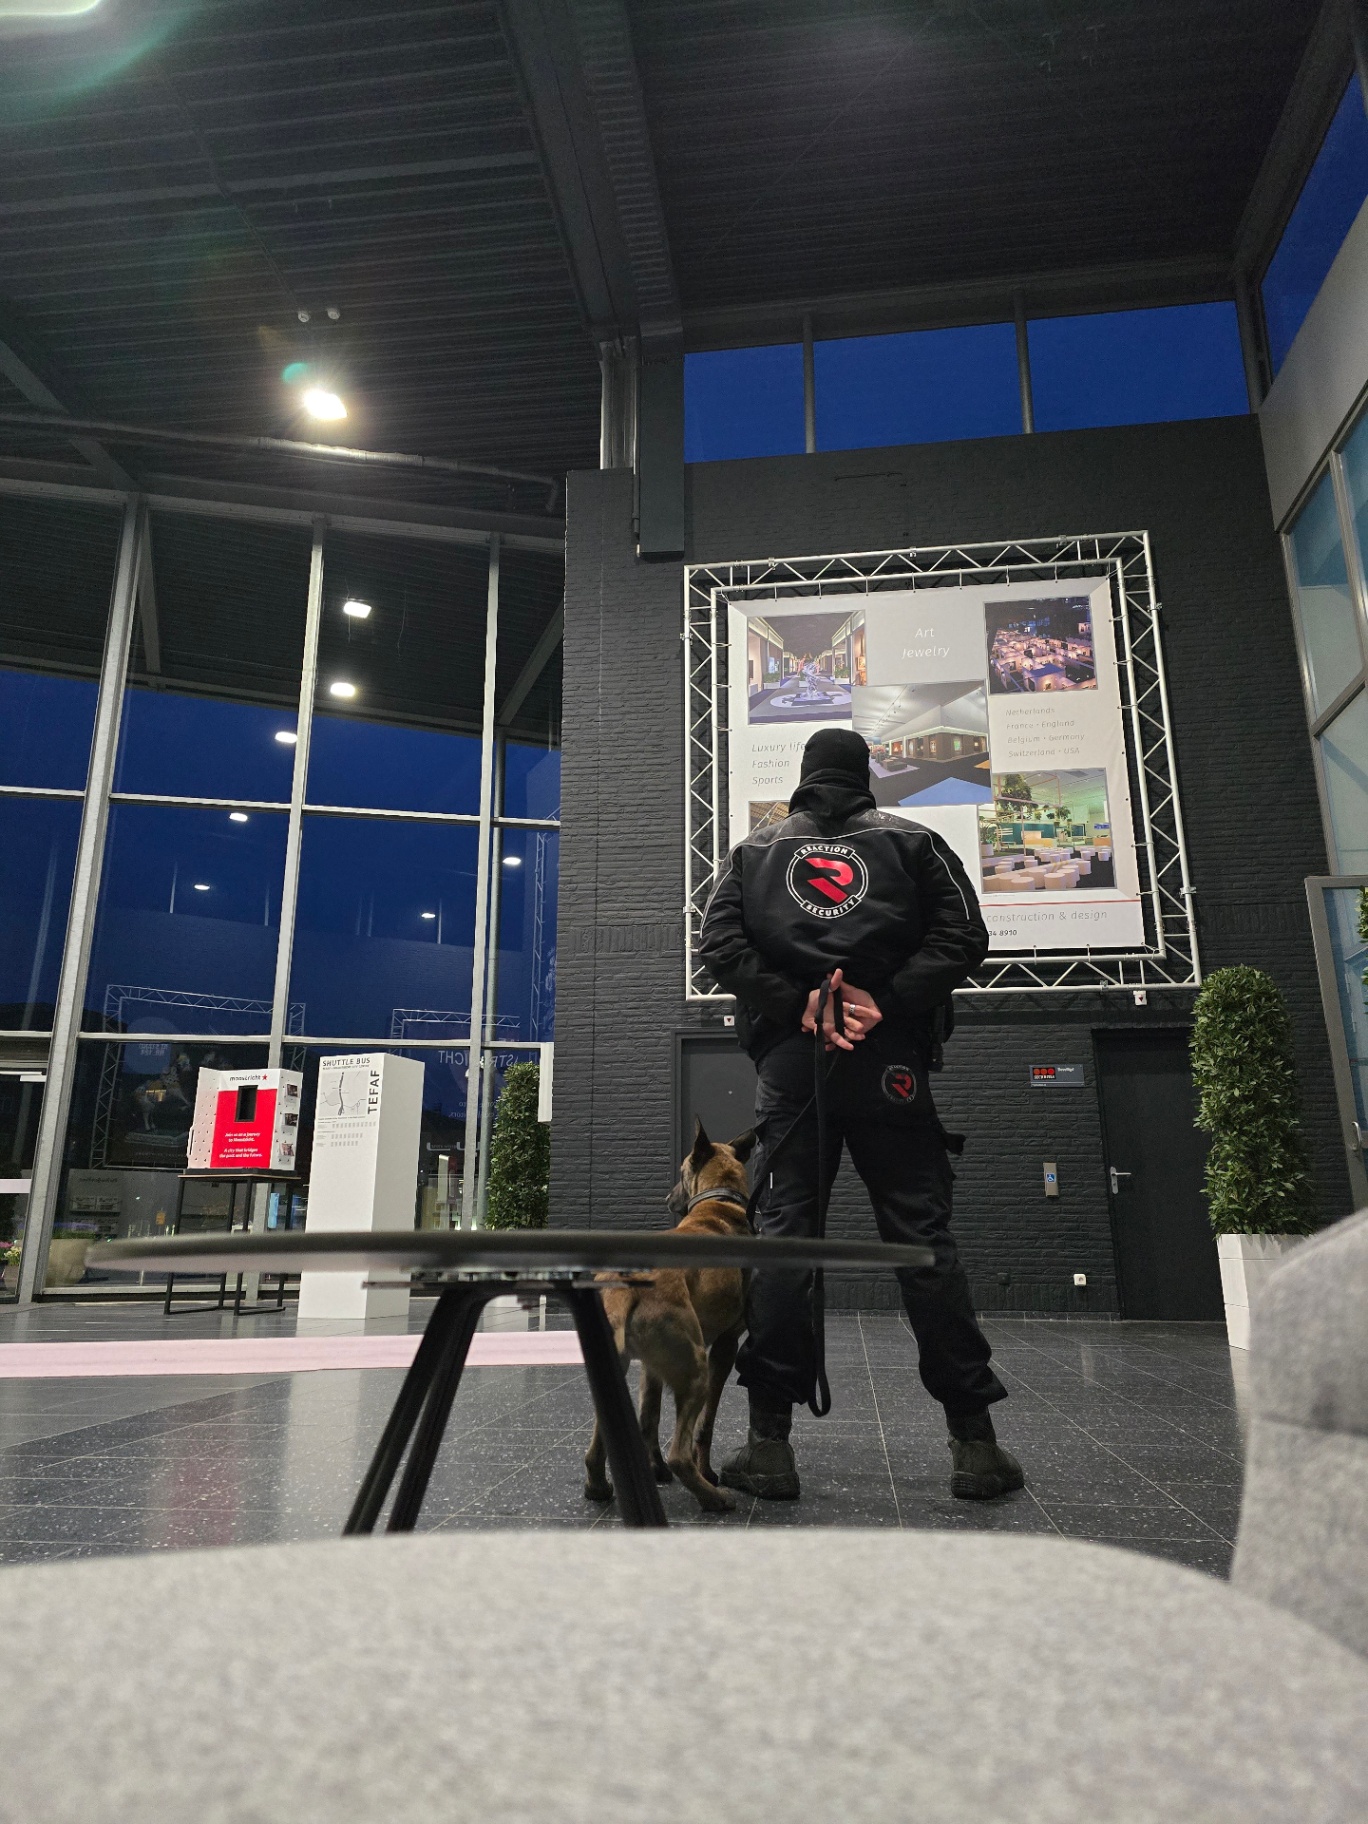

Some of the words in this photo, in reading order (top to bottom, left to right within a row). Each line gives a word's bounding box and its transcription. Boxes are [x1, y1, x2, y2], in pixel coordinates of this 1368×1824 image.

[914, 627, 935, 639] Art
[901, 645, 951, 660] Jewelry
[1005, 707, 1055, 716] Netherlands
[1006, 722, 1034, 730] France
[1041, 720, 1075, 729] England
[1007, 735, 1041, 744] Belgium
[1048, 733, 1085, 742] Germany
[751, 743, 787, 753] Luxury
[1008, 748, 1056, 758] Switzerland
[1063, 746, 1080, 755] USA
[752, 758, 790, 769] Fashion
[752, 775, 784, 787] Sports
[800, 845, 849, 856] REACTION
[806, 898, 856, 917] SECURITY
[986, 911, 1055, 922] construction
[1059, 911, 1067, 920] &
[1071, 910, 1108, 921] design
[322, 1058, 354, 1067] SHUTTLE
[367, 1070, 380, 1114] TEFAF
